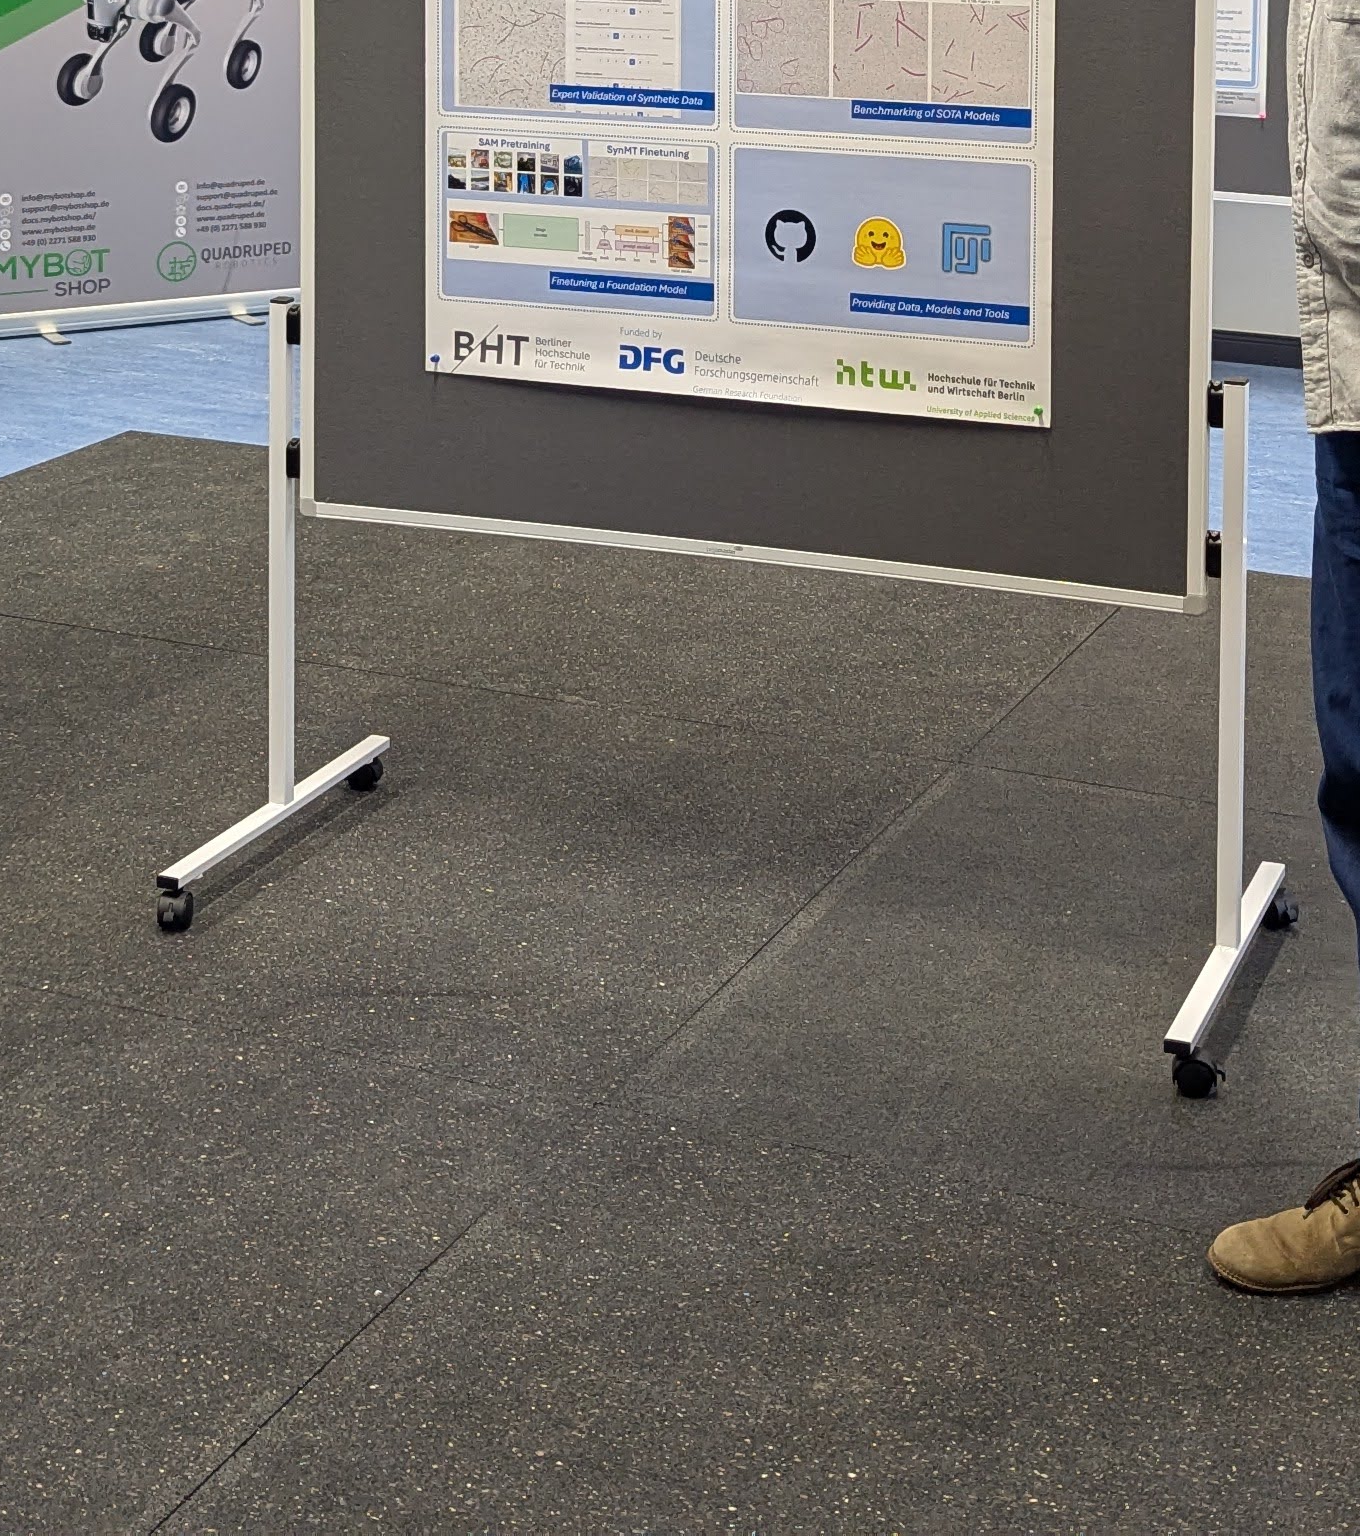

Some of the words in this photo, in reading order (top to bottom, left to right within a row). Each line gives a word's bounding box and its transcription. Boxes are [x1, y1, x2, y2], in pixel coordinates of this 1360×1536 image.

[551, 89, 580, 100] Expert
[581, 90, 626, 102] Validation
[627, 93, 637, 103] of
[638, 94, 680, 106] Synthetic
[682, 96, 703, 106] Data
[853, 104, 922, 119] Benchmarking
[923, 107, 935, 119] of
[936, 108, 963, 120] SOTA
[964, 109, 1000, 122] Models
[478, 138, 499, 148] SAM
[500, 140, 551, 152] Pretraining
[607, 145, 638, 156] SynMT
[639, 147, 690, 159] Finetuning
[197, 179, 265, 190] info@quadruped.de
[22, 191, 95, 202] info@mybotshop.de
[197, 189, 278, 201] support@quadruped.de
[22, 200, 109, 214] support@mybotshop.de
[197, 212, 265, 222] www.quadruped.de
[22, 224, 95, 236] www.mybotshop.de
[222, 223, 238, 231] 2271
[37, 238, 47, 246] (0)
[49, 236, 66, 244] 2271
[83, 234, 96, 242] 930
[201, 242, 292, 264] QUADRUPED
[55, 278, 111, 297] SHOP
[551, 276, 598, 288] Finetuning
[599, 281, 605, 289] a
[606, 280, 657, 293] Foundation
[659, 284, 688, 295] Model
[851, 298, 896, 312] Providing
[897, 302, 923, 314] Data,
[925, 303, 961, 316] Models
[963, 307, 982, 317] and
[984, 308, 1010, 320] Tools
[620, 327, 651, 338] Funded
[653, 329, 662, 340] by
[535, 336, 572, 348] Berliner
[535, 347, 591, 361] Hochschule
[619, 344, 684, 375] DFG
[694, 350, 742, 365] Deutsche
[534, 358, 548, 368] für
[550, 360, 586, 372] Technik
[694, 366, 819, 388] Forschungsgemeinschaft
[927, 373, 982, 386] Hochschule
[984, 377, 997, 388] für
[999, 379, 1036, 391] Technik
[693, 386, 723, 394] German
[725, 388, 757, 399] Research
[760, 392, 803, 402] Foundation
[927, 385, 946, 394] und
[947, 386, 995, 400] Wirtschaft
[997, 391, 1025, 402] Berlin
[926, 405, 963, 418] University
[964, 408, 973, 417] of
[974, 408, 1002, 421] Applied
[1003, 412, 1035, 423] Sciences
